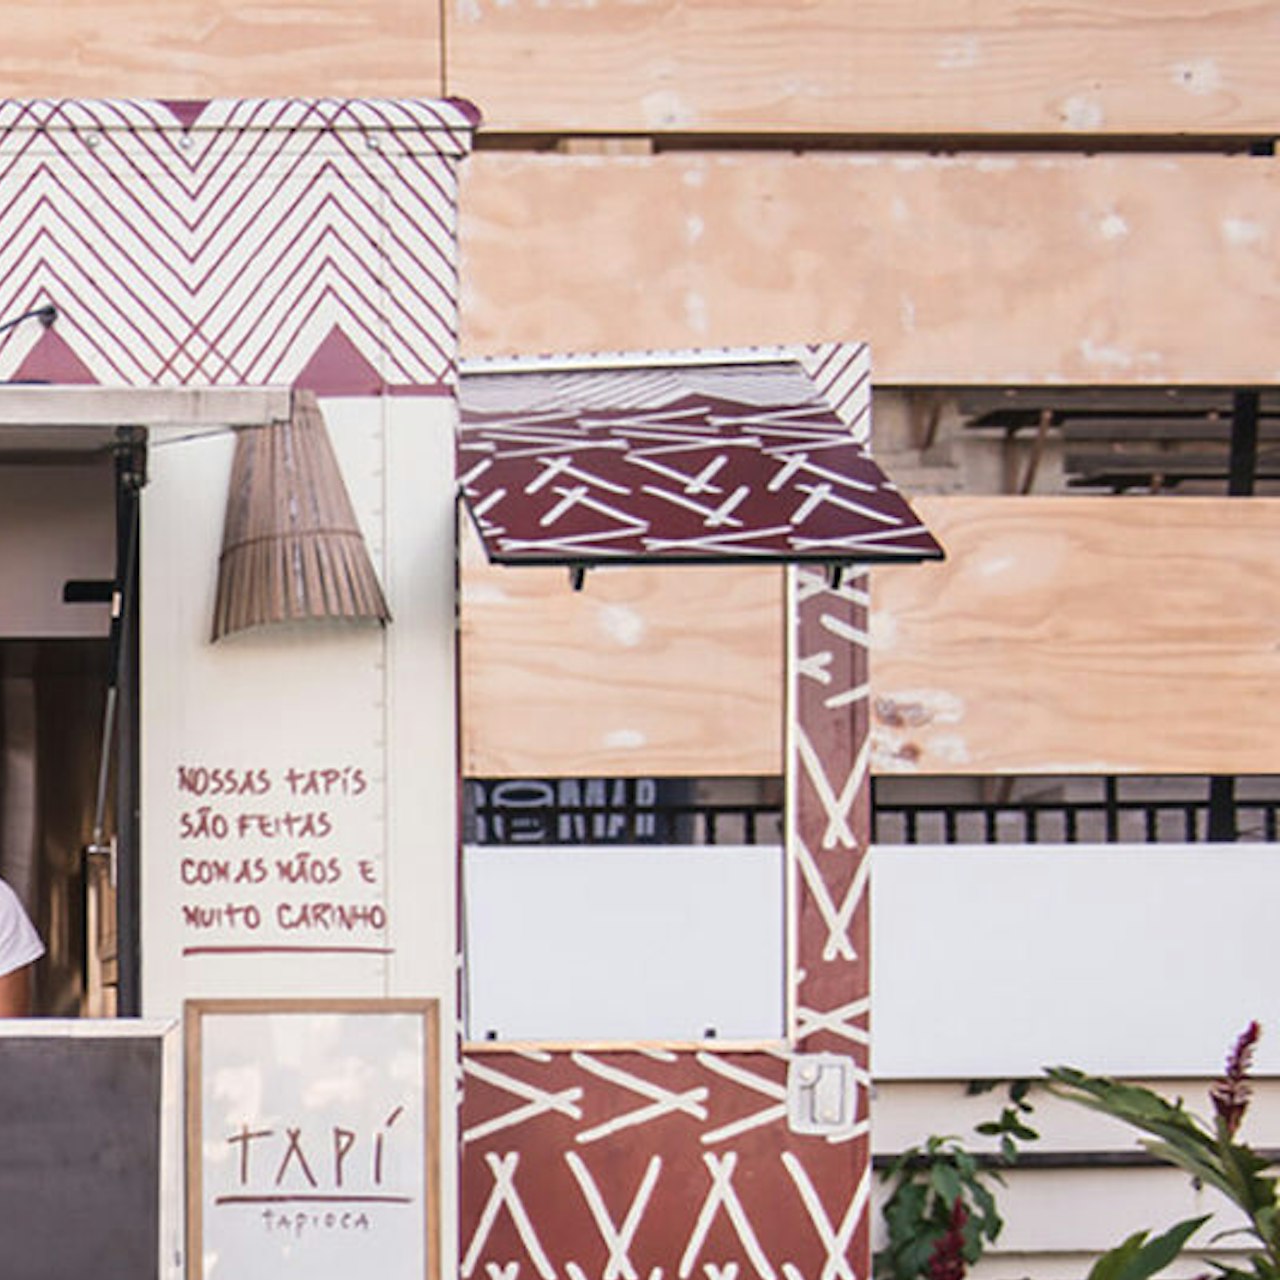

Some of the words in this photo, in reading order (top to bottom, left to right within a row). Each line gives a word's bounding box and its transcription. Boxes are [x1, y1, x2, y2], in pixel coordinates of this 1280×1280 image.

[178, 766, 271, 796] NOSSAS
[180, 807, 227, 838] SÃO
[238, 811, 332, 837] FEITAS
[276, 852, 341, 883] MÃOS
[358, 861, 377, 883] E
[182, 904, 260, 929] MUITO
[277, 903, 386, 930] CARINHO
[228, 1106, 404, 1187] TAPÍ
[262, 1209, 370, 1238] TAPIOCA
